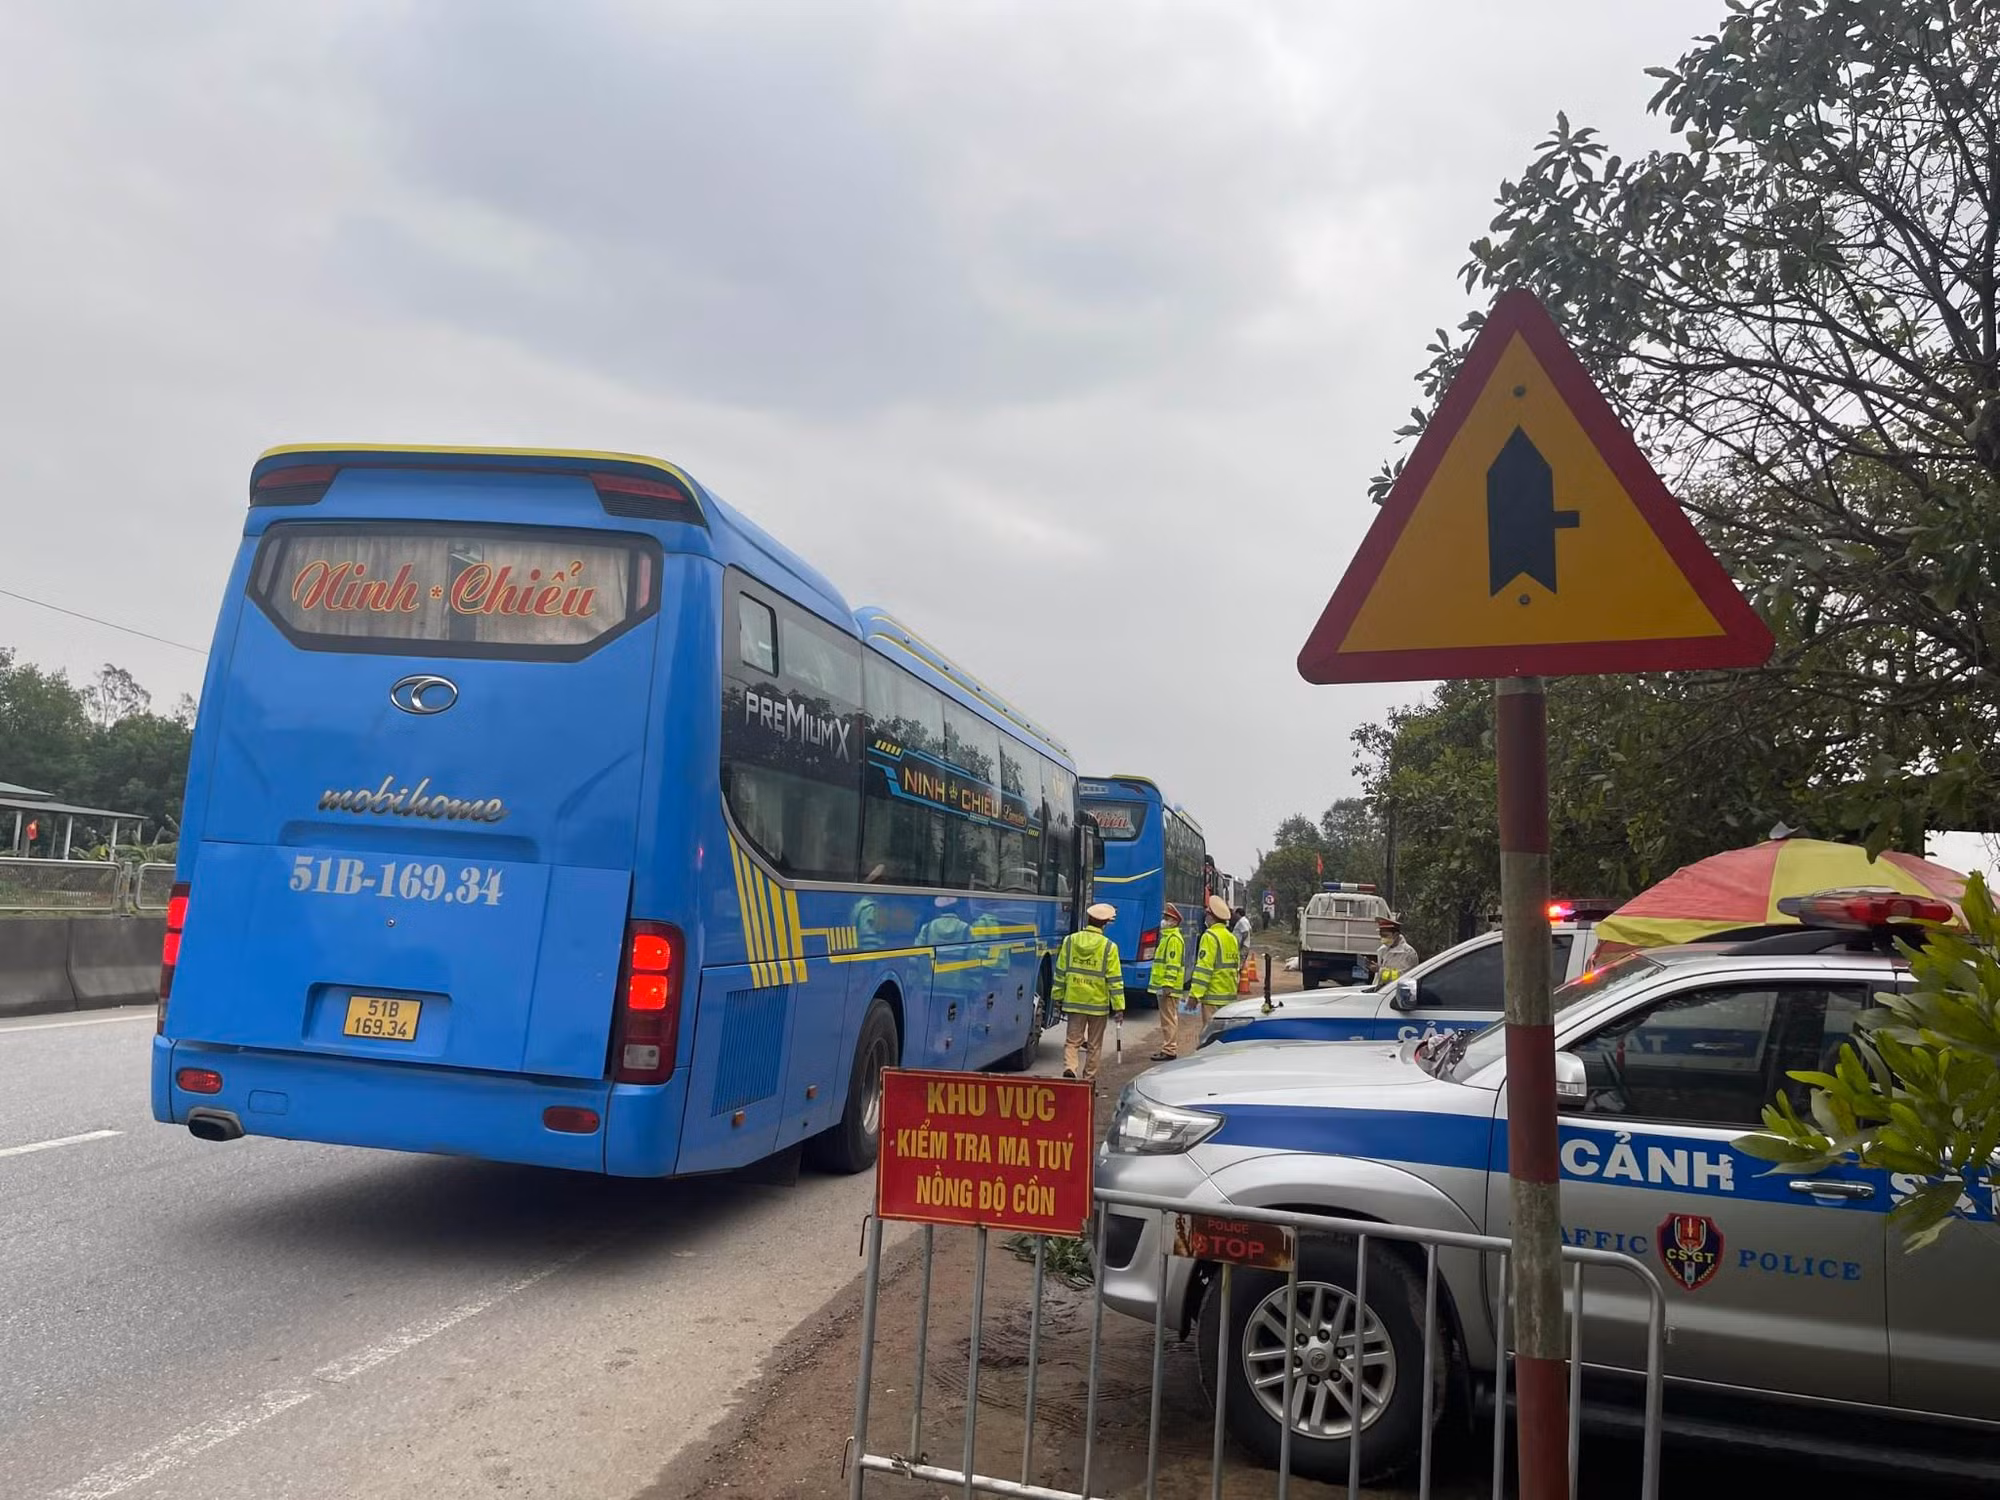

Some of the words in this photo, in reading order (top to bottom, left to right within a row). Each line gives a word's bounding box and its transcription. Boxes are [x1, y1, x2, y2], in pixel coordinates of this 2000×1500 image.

[292, 560, 419, 612] Ninh
[450, 560, 598, 618] Chiểu
[318, 775, 507, 823] mobihome
[904, 767, 945, 802] NINH
[289, 855, 504, 906] 51B-169.34
[354, 1018, 407, 1038] 169.34
[368, 1000, 400, 1018] 51B
[927, 1082, 987, 1117] KHU
[997, 1085, 1056, 1126] VỰC
[897, 1119, 948, 1160] KIỂM
[954, 1132, 992, 1163] TRA
[998, 1136, 1031, 1167] MA
[1036, 1132, 1074, 1171] TUÝ
[1560, 1131, 1735, 1191] CẢNH
[916, 1164, 973, 1208] NỒNG
[979, 1176, 1007, 1217] ĐỘ
[1012, 1174, 1056, 1216] CỒN
[1192, 1231, 1265, 1259] STOP
[1208, 1219, 1249, 1235] POLICE
[1561, 1226, 1649, 1254] AFFIC
[1738, 1249, 1861, 1280] POLICE
[1666, 1248, 1714, 1264] CSGT
